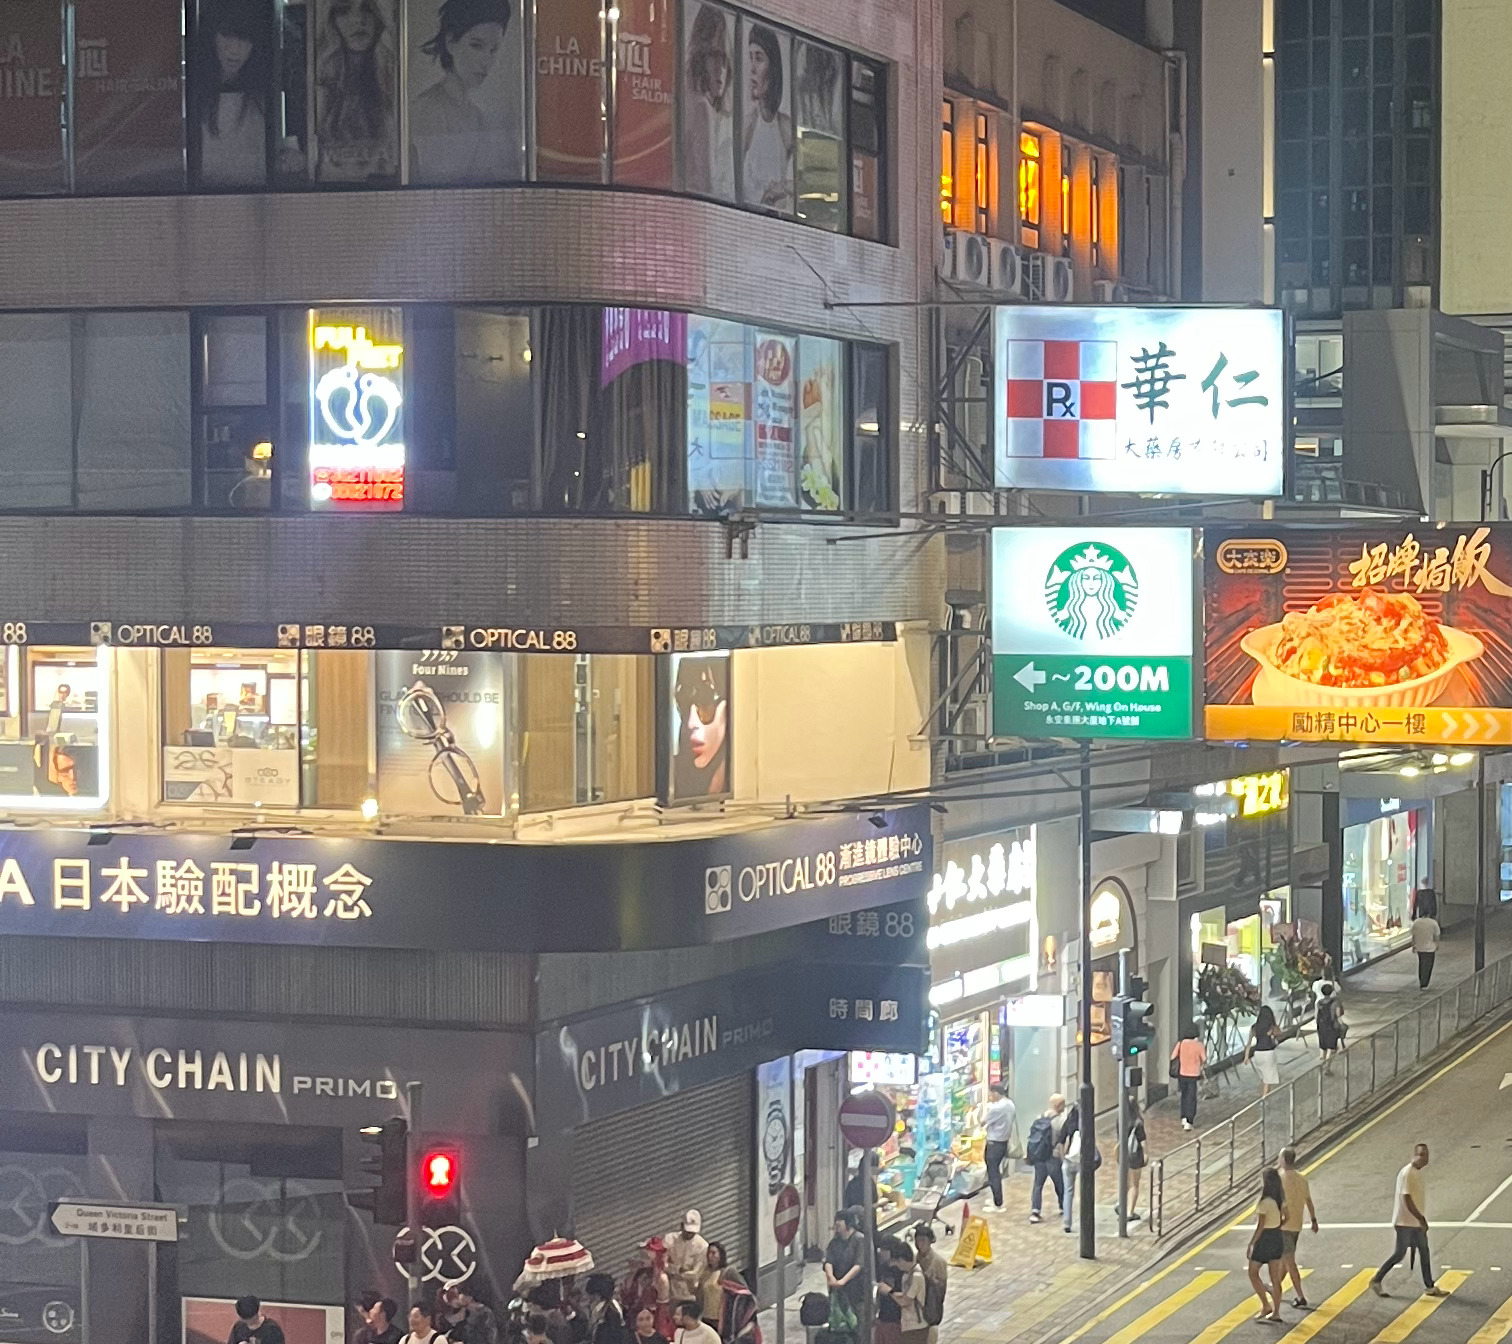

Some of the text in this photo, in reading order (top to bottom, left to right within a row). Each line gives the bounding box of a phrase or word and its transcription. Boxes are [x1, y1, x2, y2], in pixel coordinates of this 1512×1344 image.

[555, 35, 580, 55] LA
[538, 57, 601, 77] CHINE
[632, 77, 662, 91] HAIR
[632, 88, 672, 104] SALON
[1121, 341, 1269, 425] 華仁
[3, 622, 27, 644] 88
[117, 624, 213, 645] OPTICAL 88
[469, 628, 578, 650] OPTICAL 88
[763, 624, 800, 644] OPTICAL
[412, 664, 469, 676] Four Nines
[1024, 701, 1049, 713] Shop
[1085, 701, 1112, 714] Wing
[1114, 702, 1128, 712] On
[1130, 702, 1162, 713] House
[738, 850, 836, 902] OPTICAL 88
[53, 856, 374, 920] 日本驗配概念
[829, 997, 899, 1022] 時間廊
[581, 1038, 639, 1091] CITY
[646, 1015, 717, 1071] CHAIN
[36, 1043, 398, 1100] CITY CHAIN PRIMO
[76, 1208, 168, 1222] Queen Victoria Street
